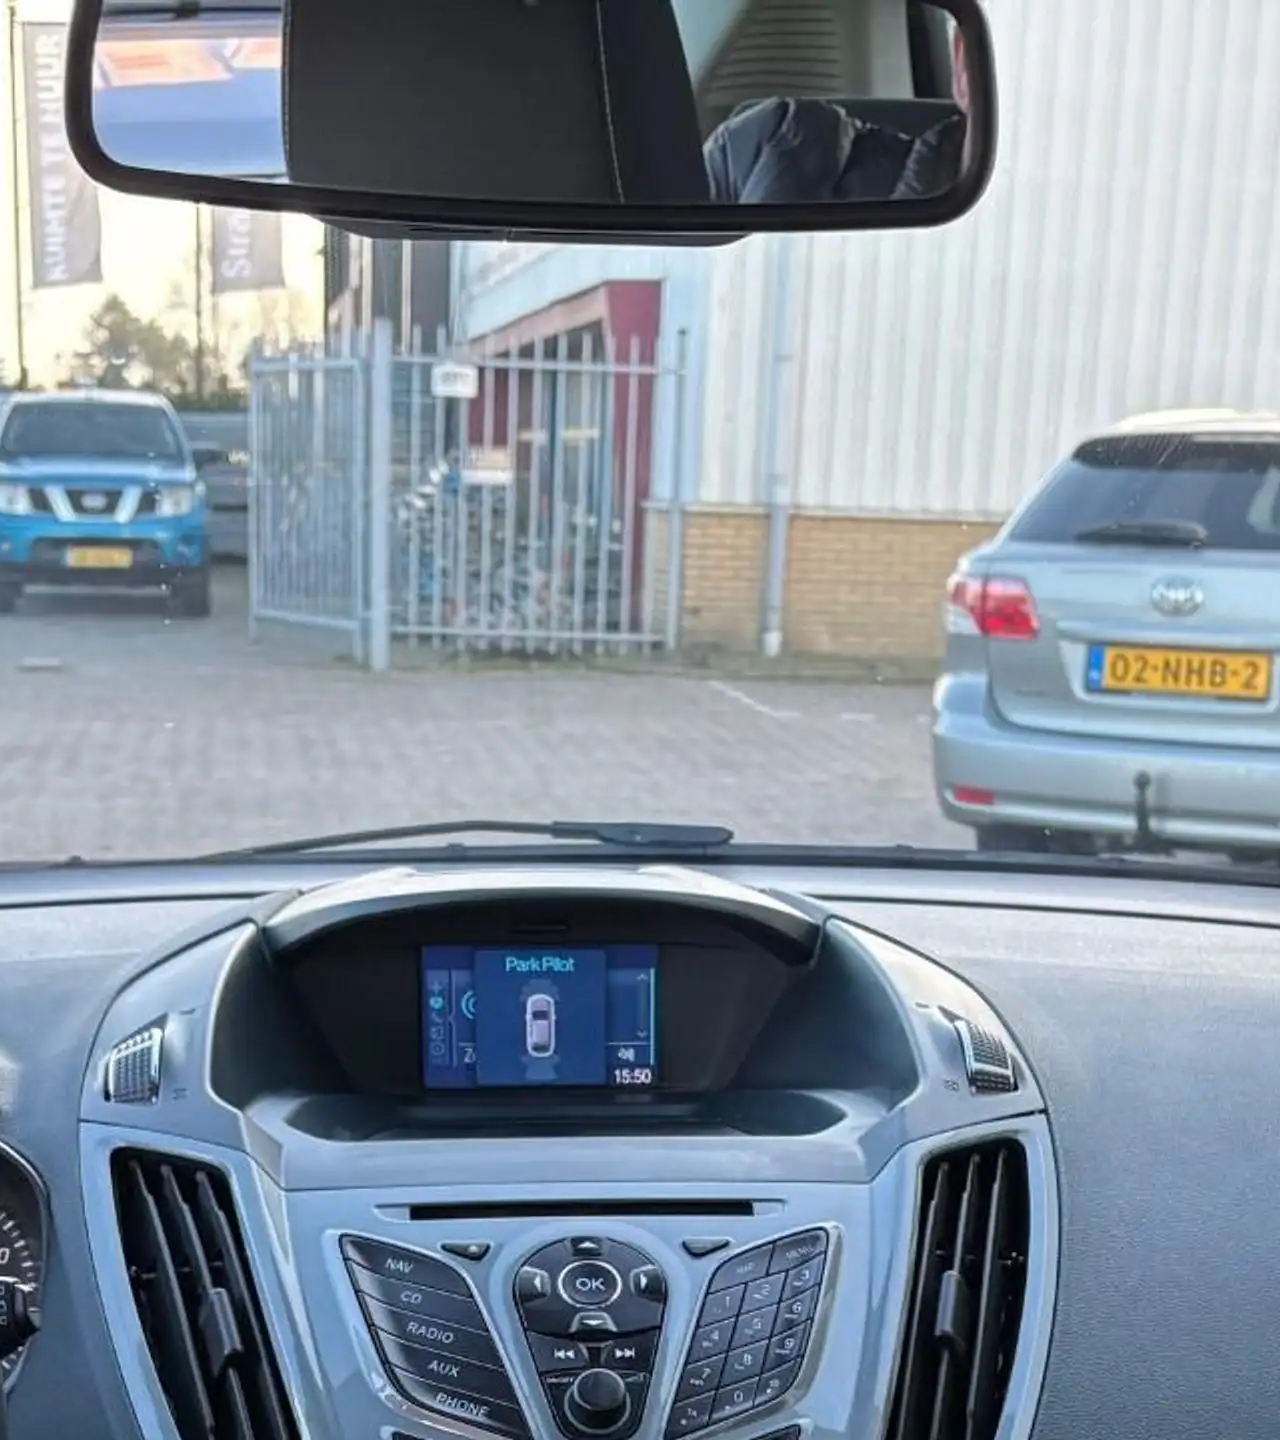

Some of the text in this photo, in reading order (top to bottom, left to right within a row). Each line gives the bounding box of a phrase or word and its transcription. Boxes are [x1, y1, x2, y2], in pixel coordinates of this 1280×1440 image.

[1110, 652, 1262, 690] 02-NHB-2
[505, 955, 574, 972] Park Pilot
[614, 1068, 652, 1084] 15:50
[384, 1257, 414, 1274] NAV
[576, 1277, 606, 1291] OK
[401, 1290, 423, 1303] CD
[407, 1321, 454, 1344] RADIO
[427, 1359, 461, 1378] AUX
[435, 1392, 490, 1418] PHONE
